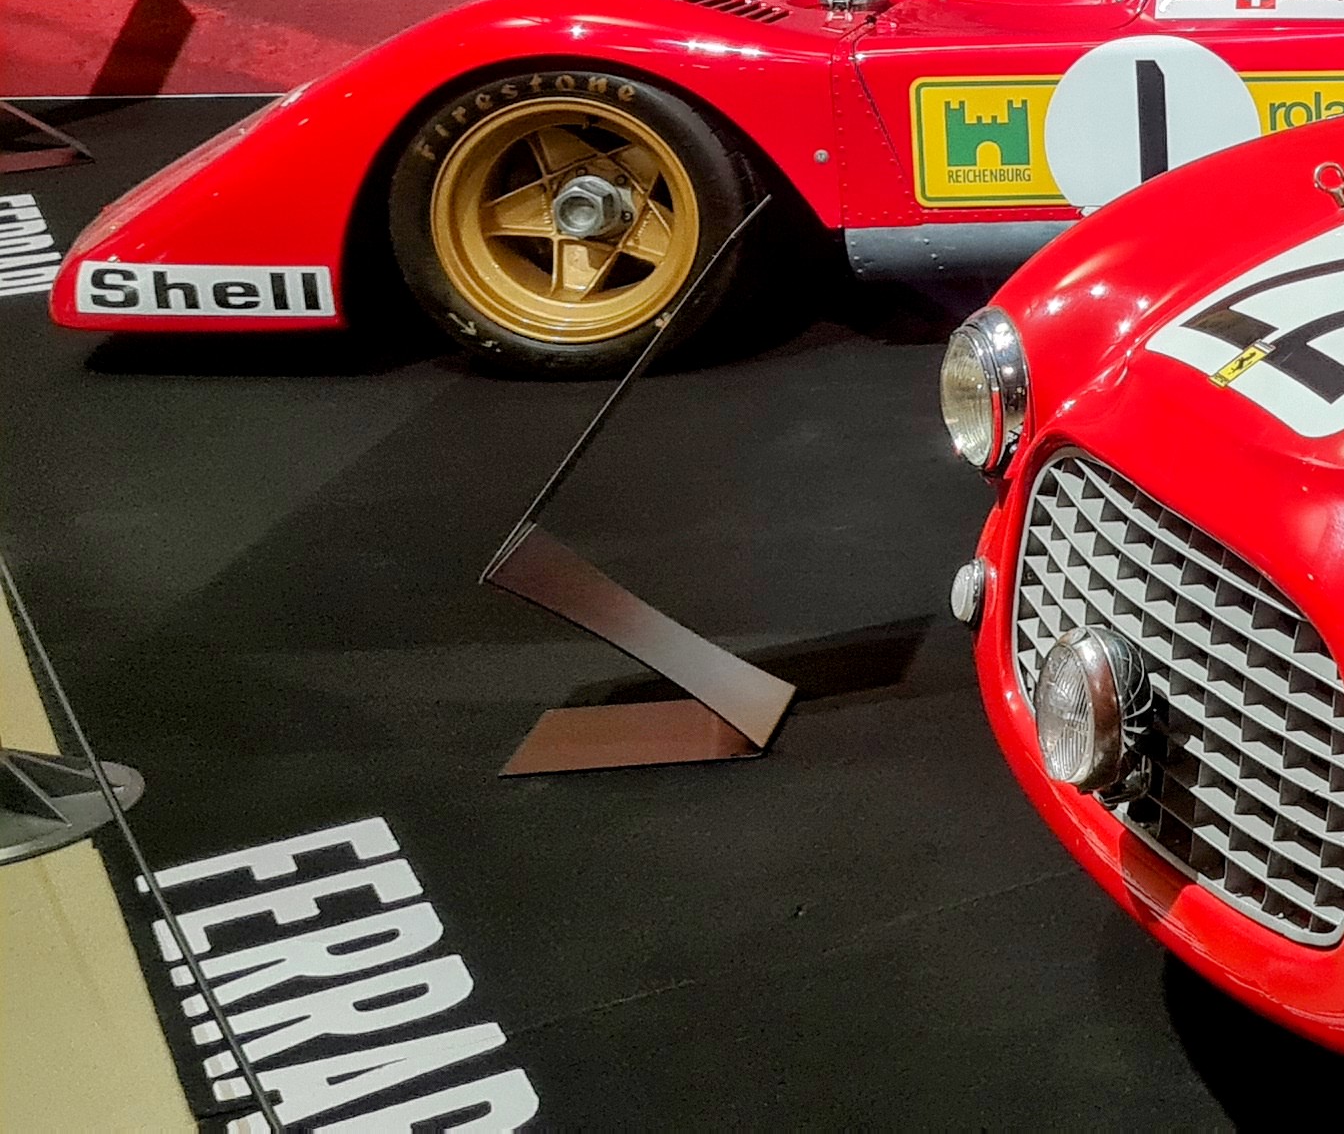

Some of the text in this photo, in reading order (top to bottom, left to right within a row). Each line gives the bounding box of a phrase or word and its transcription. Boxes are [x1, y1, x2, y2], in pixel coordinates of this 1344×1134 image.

[412, 71, 637, 162] Firestone
[1135, 59, 1168, 184] 1
[947, 167, 1032, 183] REICHENBURG
[90, 268, 322, 311] Shell
